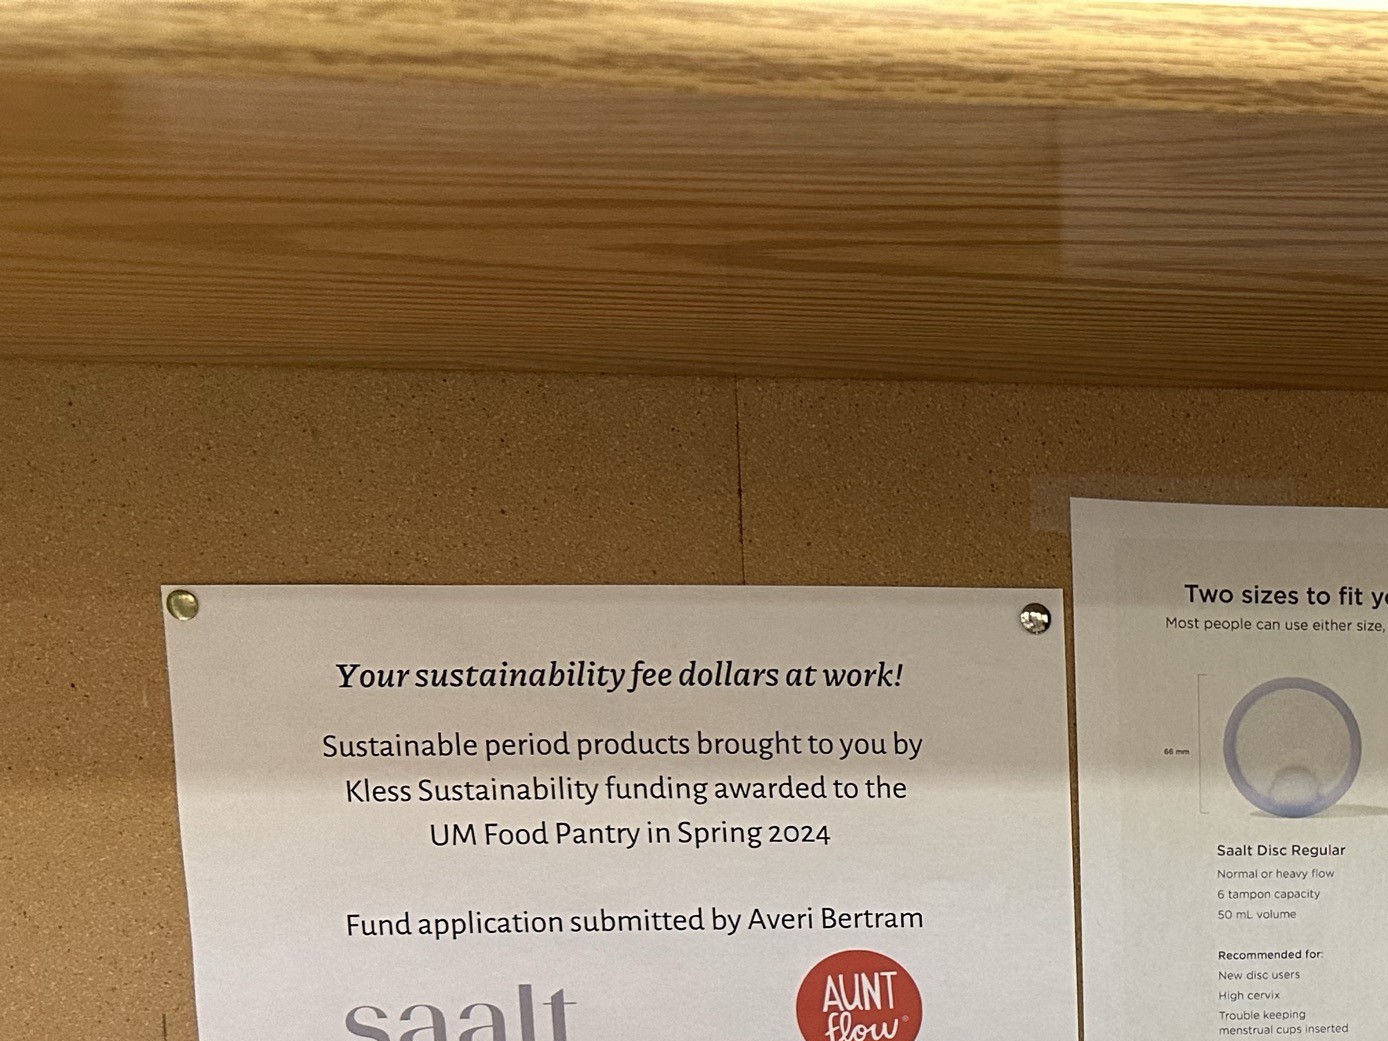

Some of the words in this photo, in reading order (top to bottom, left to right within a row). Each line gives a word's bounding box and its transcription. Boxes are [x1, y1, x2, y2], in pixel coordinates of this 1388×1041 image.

[1185, 584, 1233, 603] Two
[1242, 585, 1298, 604] sizes
[1307, 587, 1330, 605] to
[1339, 586, 1363, 605] fit
[1166, 617, 1199, 629] Most
[1204, 618, 1251, 631] people
[1256, 621, 1280, 630] can
[1285, 622, 1308, 631] use
[1313, 619, 1352, 631] either
[1357, 620, 1385, 633] size,
[336, 664, 410, 688] Your
[414, 660, 624, 692] sustainability
[624, 659, 673, 694] fee
[679, 661, 778, 686] dollars
[786, 666, 817, 686] at
[823, 661, 903, 687] work!
[323, 732, 477, 757] Sustainable
[486, 731, 570, 761] period
[578, 731, 689, 760] products
[698, 731, 802, 760] brought
[808, 736, 833, 754] to
[839, 738, 887, 760] you
[894, 731, 922, 760] by
[347, 778, 411, 802] Kless
[419, 776, 598, 805] Sustainability
[605, 775, 708, 805] funding
[715, 775, 827, 798] awarded
[833, 780, 858, 798] to
[865, 775, 906, 798] the
[431, 824, 476, 846] UM
[485, 821, 548, 845] Food
[556, 823, 640, 849] Pantry
[648, 821, 670, 843] in
[678, 821, 762, 848] Spring
[769, 826, 830, 845] 2024
[1218, 845, 1252, 856] Saalt
[1258, 845, 1287, 856] Disc
[1292, 845, 1345, 857] Regular
[1218, 869, 1257, 879] Normal
[1261, 871, 1273, 879] or
[1276, 869, 1308, 880] heavy
[1312, 869, 1334, 878] flow
[1218, 890, 1224, 899] 6
[1228, 891, 1270, 900] tampon
[1274, 890, 1320, 900] capacity
[1218, 910, 1232, 919] 50
[1236, 910, 1253, 919] mL
[1257, 910, 1296, 919] volume
[347, 912, 412, 936] Fund
[419, 911, 563, 940] application
[571, 907, 705, 932] submitted
[712, 907, 741, 935] by
[748, 907, 812, 929] Averi
[822, 908, 922, 928] Bertram
[1219, 950, 1301, 960] Recommended
[1305, 950, 1323, 958] for:
[1219, 971, 1242, 980] New
[1246, 971, 1268, 980] disc
[1272, 971, 1300, 979] users
[822, 971, 898, 1013] AUNT
[1219, 991, 1244, 1002] High
[1219, 1011, 1260, 1020] Trouble
[1263, 1010, 1305, 1020] keeping
[1219, 1025, 1273, 1035] menstrual
[1276, 1026, 1302, 1035] cups
[1306, 1024, 1348, 1033] inserted
